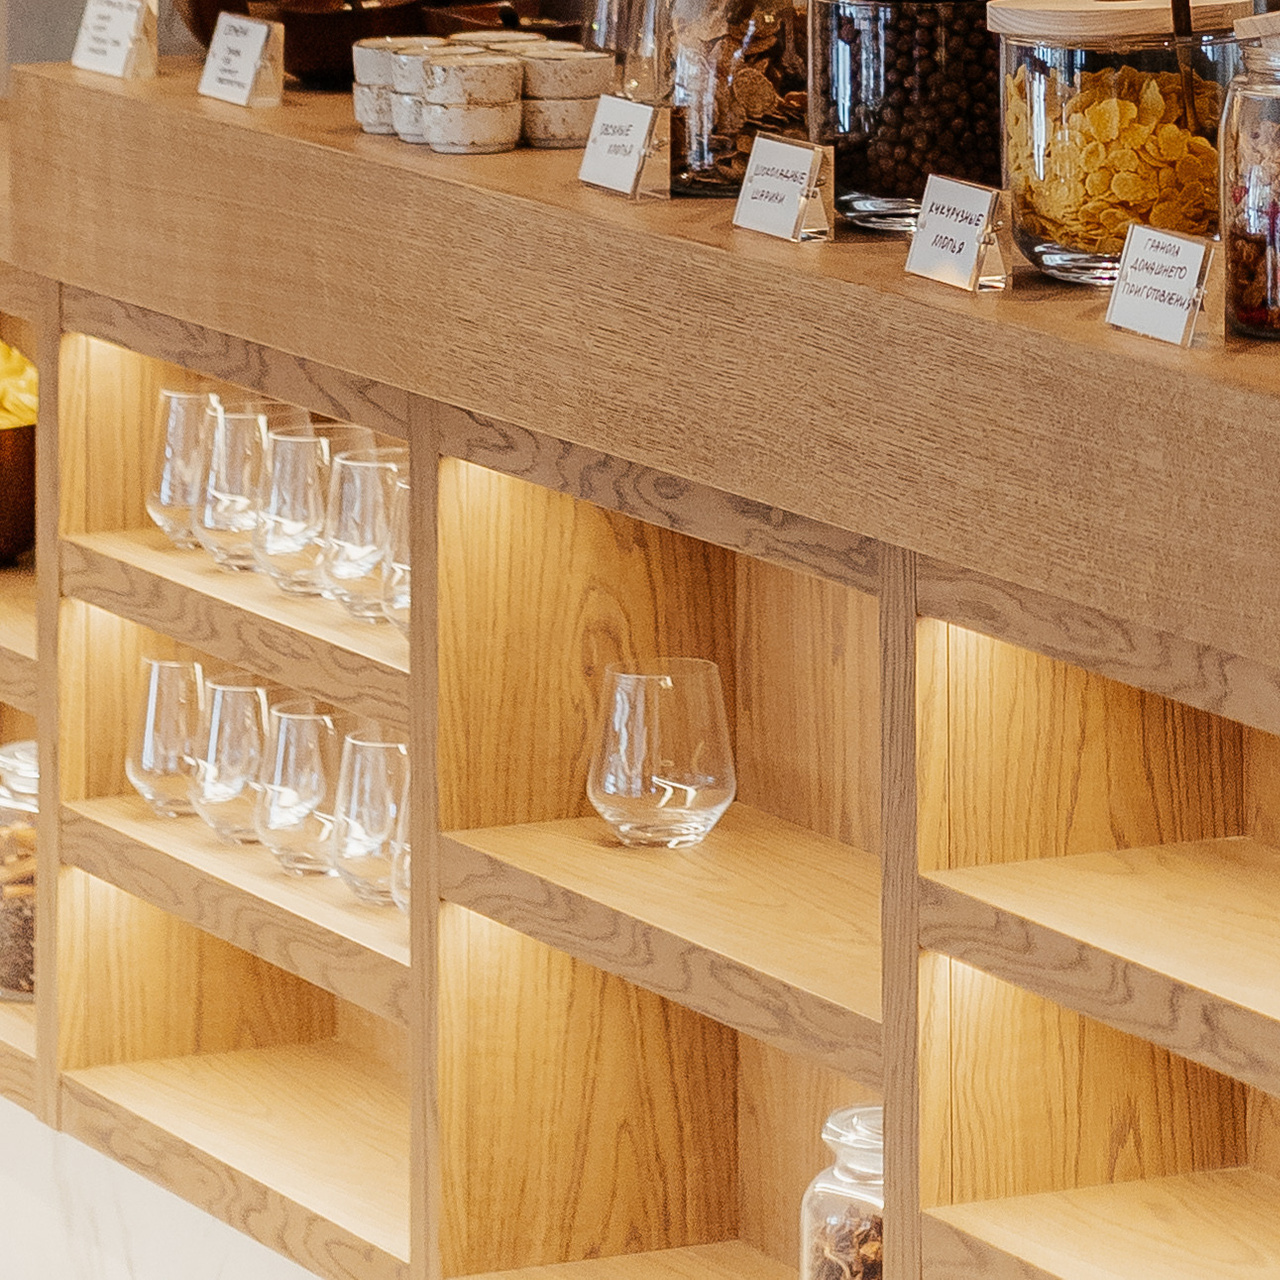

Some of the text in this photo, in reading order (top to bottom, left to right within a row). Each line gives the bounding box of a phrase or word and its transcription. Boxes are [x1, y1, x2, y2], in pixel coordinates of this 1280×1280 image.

[750, 188, 786, 205] ШАРИКИ
[928, 201, 985, 227] КУКУРУЗНЫЕ
[931, 233, 967, 254] ХЛОПЬЯ
[1143, 237, 1181, 258] ГРАНОЛА
[1129, 257, 1188, 280] ДОМАШНЕГО
[1121, 282, 1193, 312] ПРИГОТОВЛЕНИЯ
